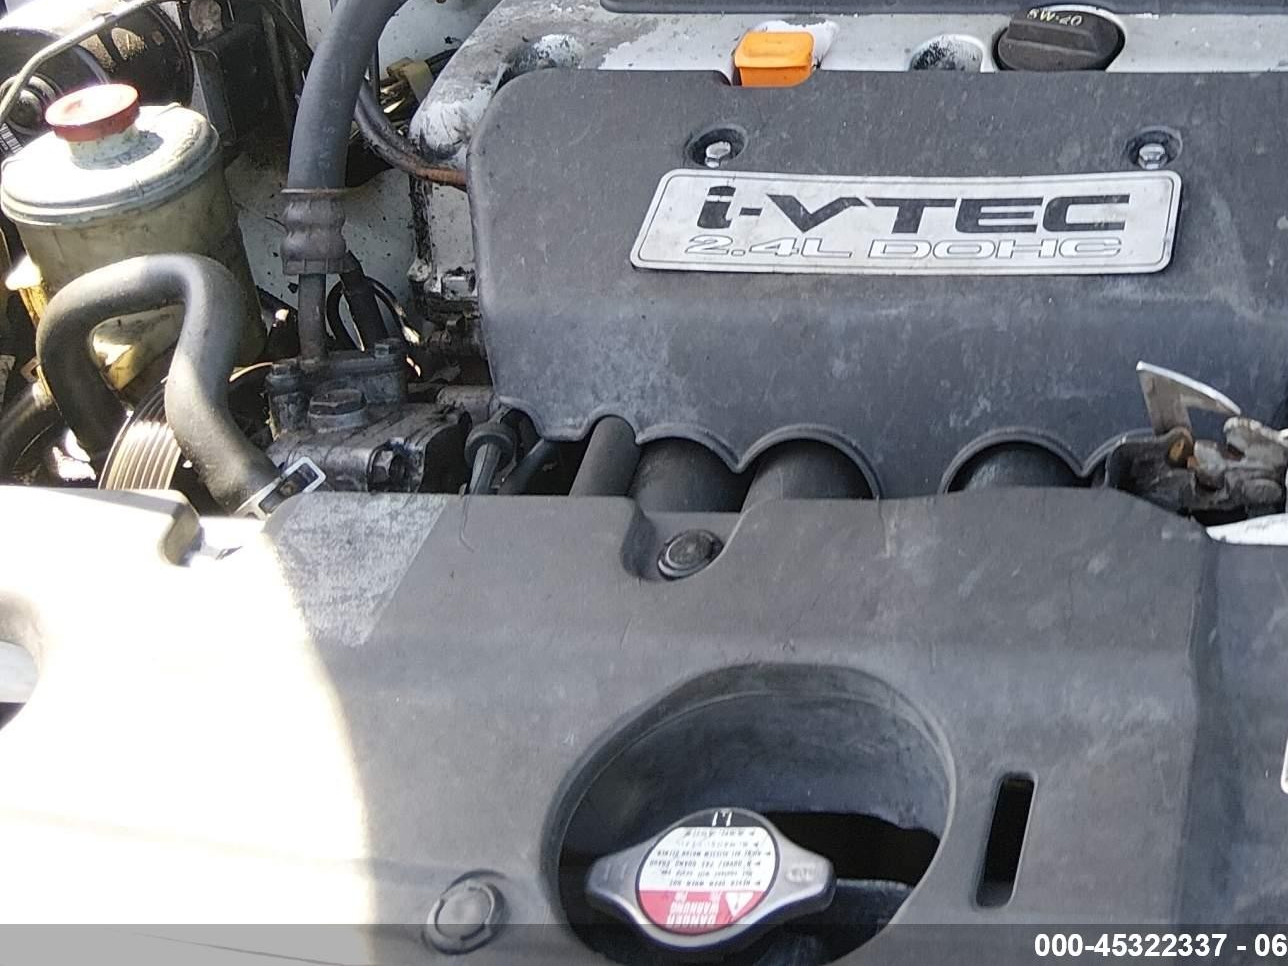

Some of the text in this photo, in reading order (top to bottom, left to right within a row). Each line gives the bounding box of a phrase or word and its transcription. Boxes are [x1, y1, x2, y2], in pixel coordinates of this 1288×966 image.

[697, 185, 1131, 234] i-VTEC
[684, 234, 1123, 260] 2.4L DOHC
